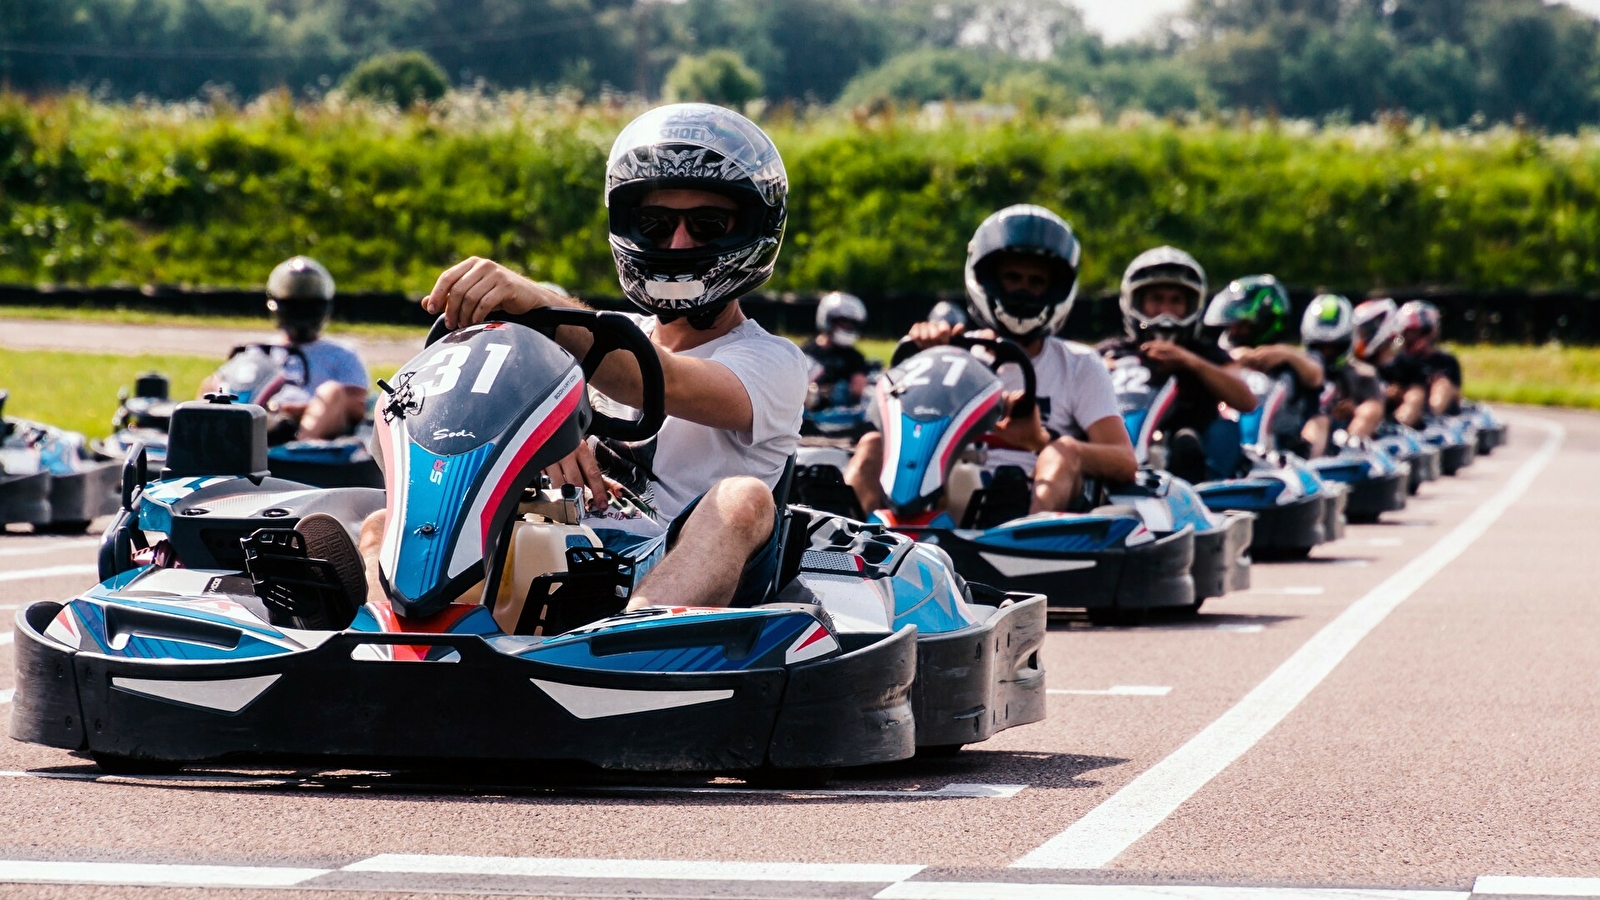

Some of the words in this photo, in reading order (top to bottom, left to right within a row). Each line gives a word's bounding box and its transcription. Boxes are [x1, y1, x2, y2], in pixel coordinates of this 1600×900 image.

[409, 343, 512, 397] 31
[902, 355, 967, 387] 27
[433, 428, 476, 440] Sodi
